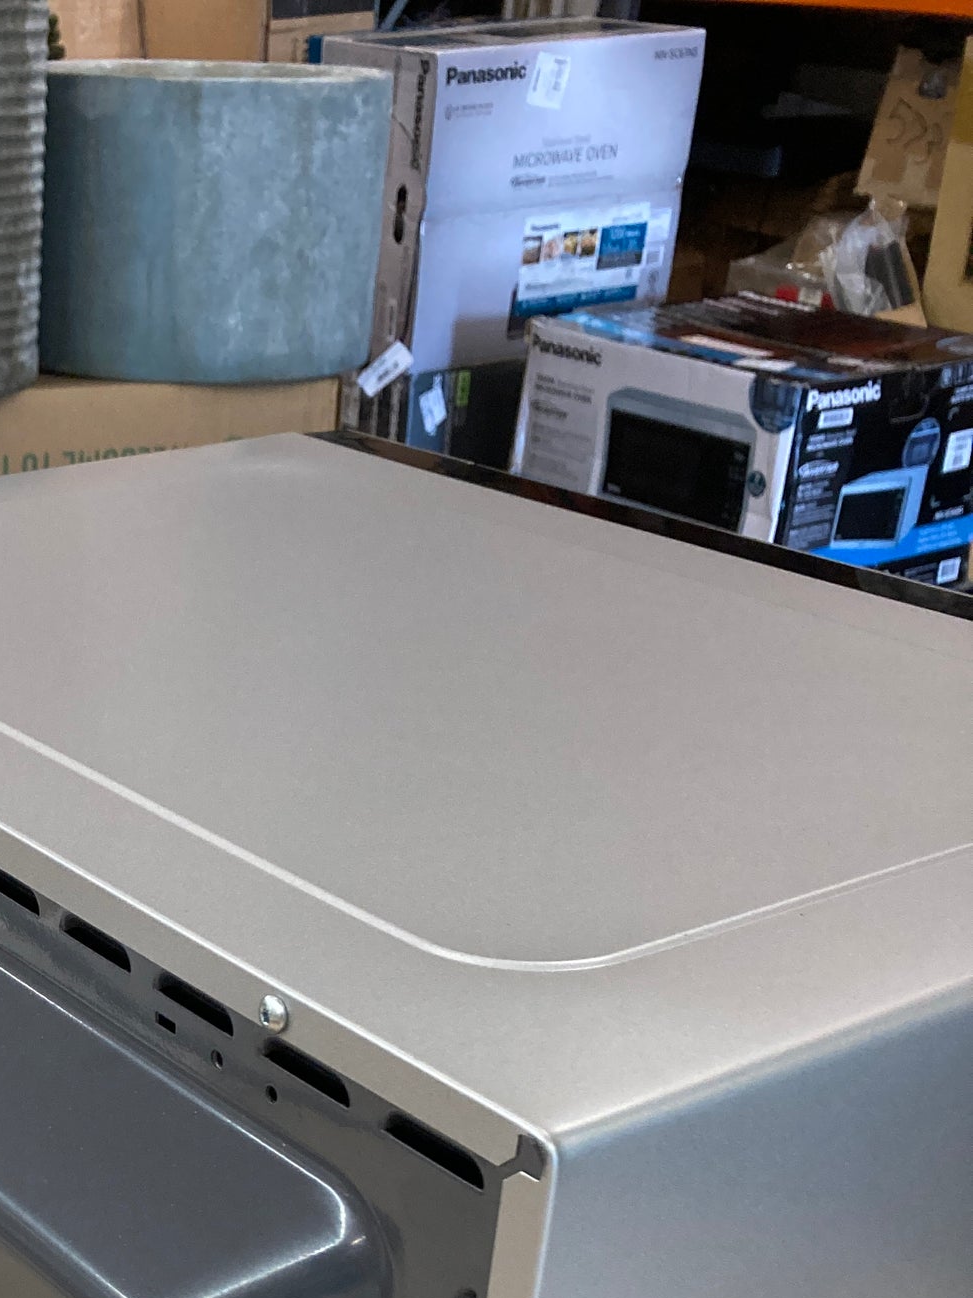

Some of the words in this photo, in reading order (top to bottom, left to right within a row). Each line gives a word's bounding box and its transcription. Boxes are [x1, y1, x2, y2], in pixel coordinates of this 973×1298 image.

[445, 61, 527, 85] Panasonic
[410, 59, 430, 171] Panasonic
[512, 147, 582, 169] MICROWAVE
[585, 144, 619, 163] OVEN
[532, 334, 602, 366] Panasonic
[806, 380, 882, 412] Panasonic
